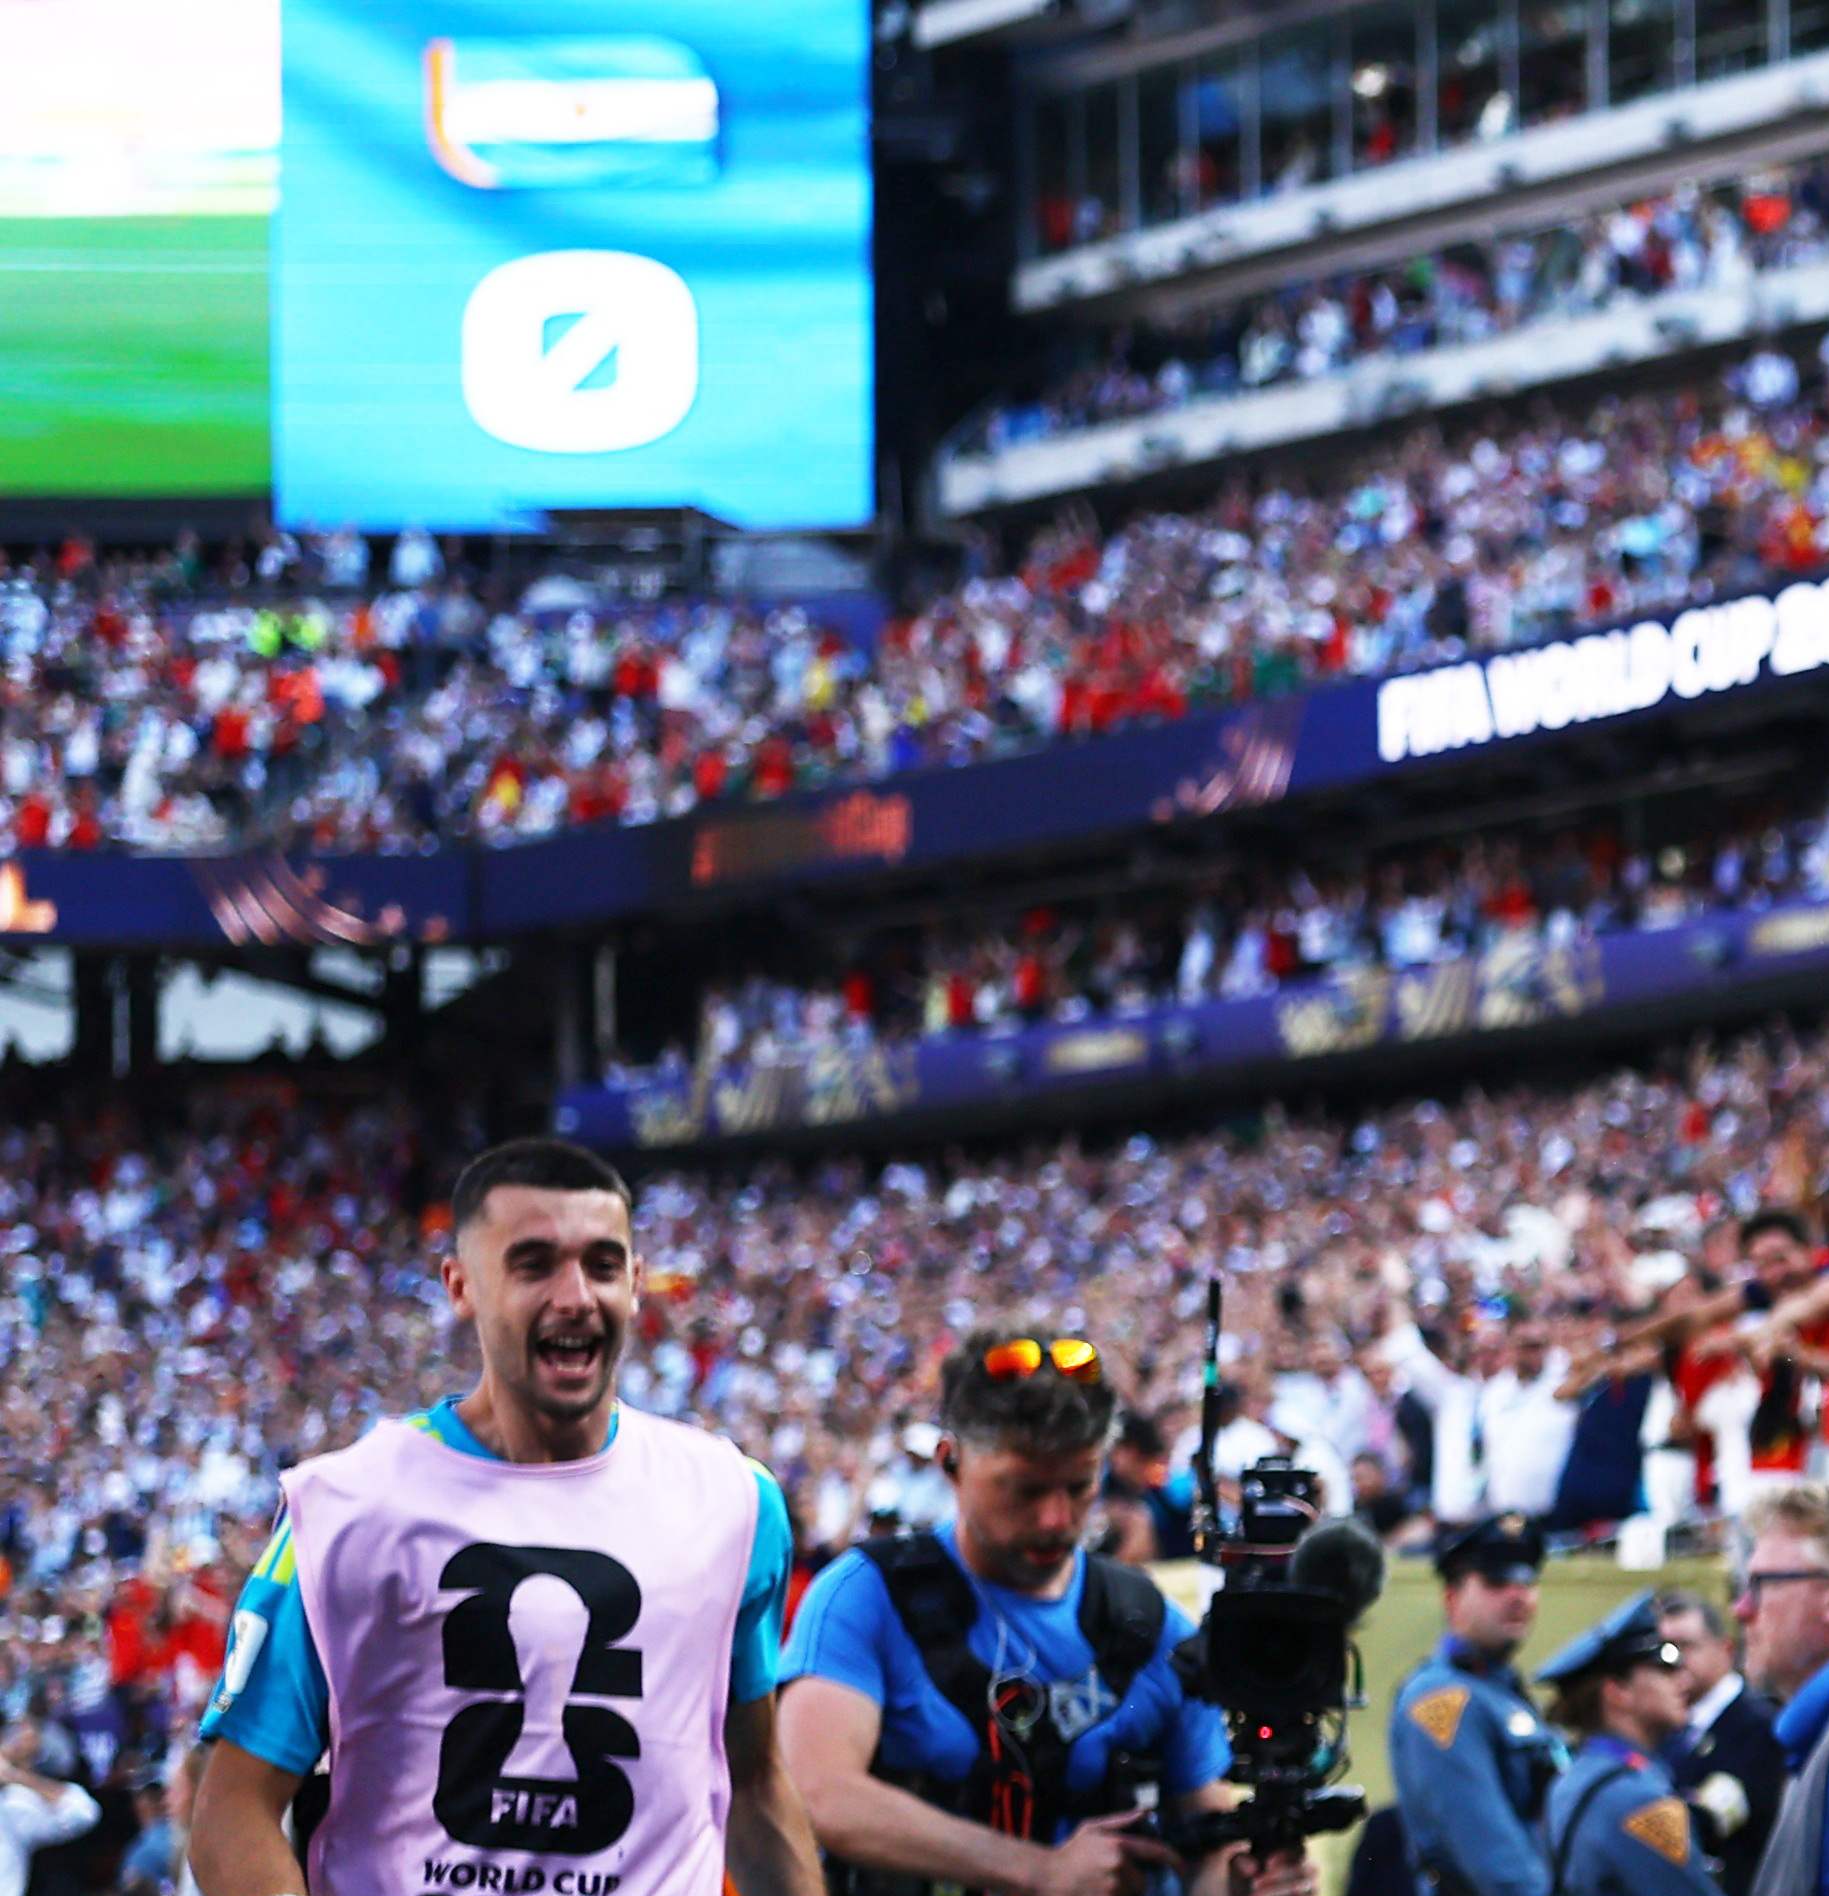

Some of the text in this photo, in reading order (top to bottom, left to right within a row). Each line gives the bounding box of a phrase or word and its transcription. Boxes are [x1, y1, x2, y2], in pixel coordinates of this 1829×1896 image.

[1378, 660, 1495, 763] FIFA
[1487, 620, 1671, 739] WORLD
[1671, 595, 1776, 698] CUP
[490, 1788, 579, 1828] FIFA
[424, 1859, 546, 1892] WORLD
